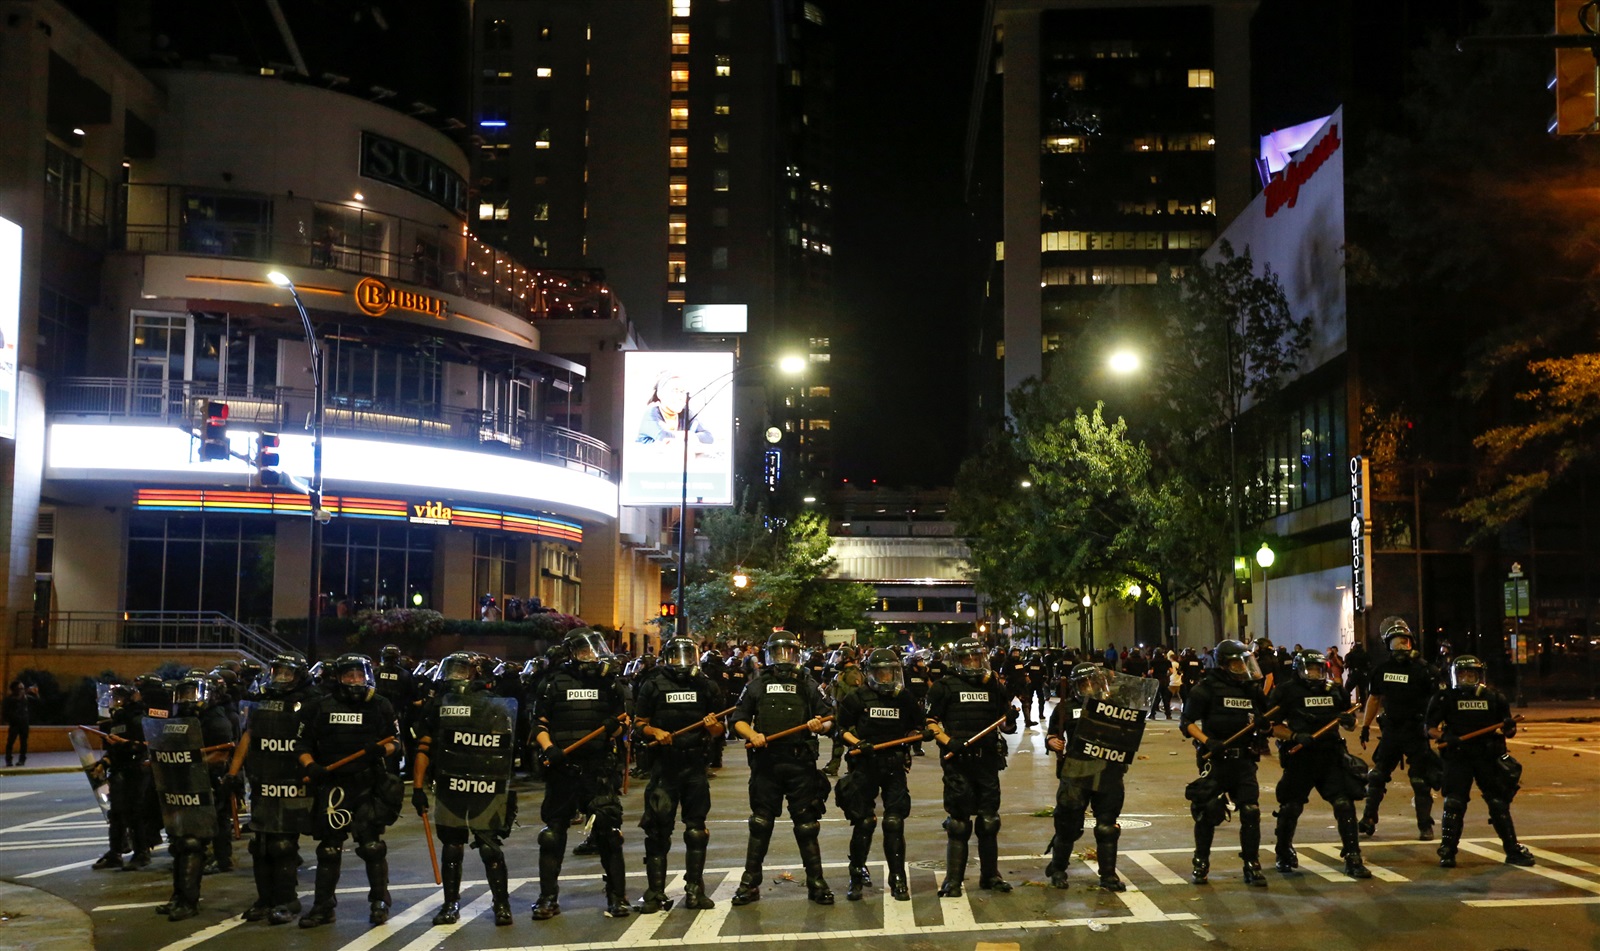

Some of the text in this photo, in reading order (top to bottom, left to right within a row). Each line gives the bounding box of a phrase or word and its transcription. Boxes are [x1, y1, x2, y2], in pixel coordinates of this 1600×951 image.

[360, 281, 449, 320] BUBBLE
[1350, 457, 1358, 514] OMNI
[413, 500, 452, 519] vida
[1352, 539, 1360, 610] HOTEL
[1384, 674, 1408, 682] POLICE
[568, 690, 597, 699] POLICE
[667, 693, 695, 702] POLICE
[961, 693, 988, 701] POLICE
[1225, 699, 1251, 708] POLICE
[1459, 701, 1487, 709] POLICE
[441, 707, 470, 715] POLICE
[871, 709, 898, 717] POLICE
[1096, 702, 1139, 722] POLICE
[330, 714, 361, 723] POLICE
[164, 725, 187, 733] POLICE
[261, 738, 297, 751] POLIC
[453, 731, 501, 747] POLICE
[156, 751, 192, 763] POLICE
[1083, 742, 1126, 762] POLICE
[261, 784, 306, 797] POLICE
[449, 778, 496, 793] POLICE
[166, 793, 200, 806] POLICE
